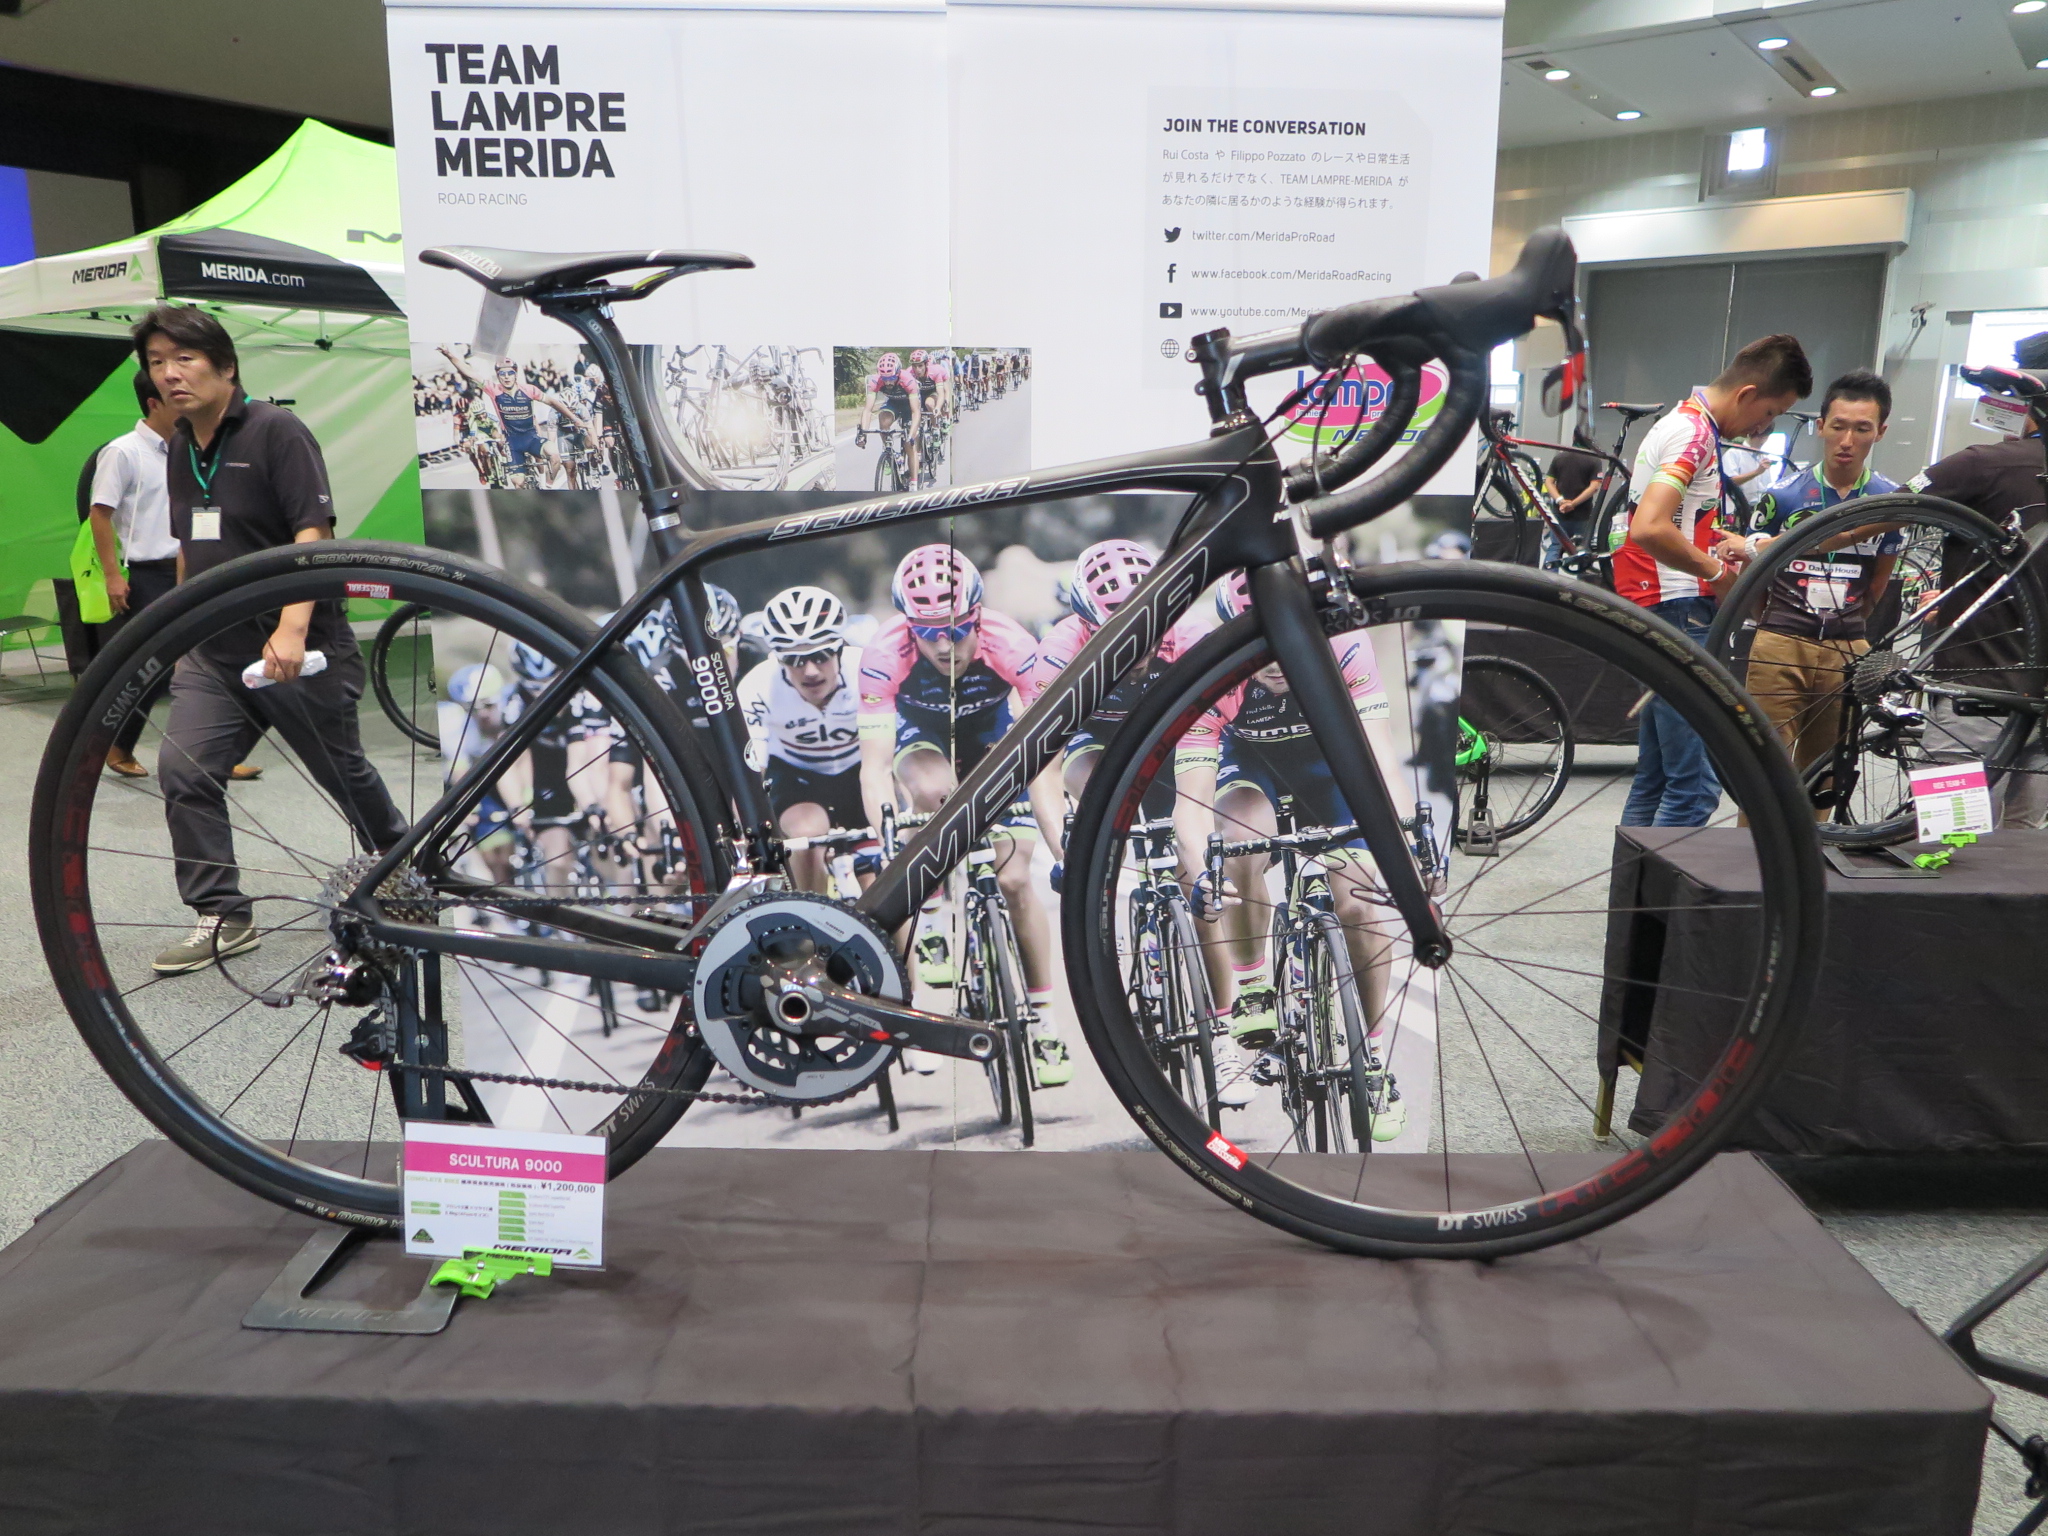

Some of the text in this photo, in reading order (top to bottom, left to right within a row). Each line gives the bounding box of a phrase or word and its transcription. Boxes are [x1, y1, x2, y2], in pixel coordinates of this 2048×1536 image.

[425, 43, 560, 85] TEAM
[431, 90, 627, 132] LAMPRE
[1163, 118, 1367, 136] JOIN THE CONVERSATION
[435, 137, 616, 178] MERIDA
[1163, 149, 1410, 165] Rui Costa や Filippo Pozzato のレースや日常生活
[1162, 171, 1409, 187] が見れるだけでなく、 TEAM LAMPRE-MERIDA が
[438, 192, 528, 206] ROAD RACING
[1162, 194, 1395, 210] あなたの隣に居るかのような経験が得られます。
[1192, 229, 1335, 243] twitter.com/MeridaProRoad
[72, 261, 128, 284] MERIDA
[200, 261, 305, 288] MERIDA.com
[1191, 269, 1391, 283] www.facebook.com/MeridaRoadRacing
[768, 476, 1031, 541] SCULTURA
[312, 553, 450, 577] CONTINENTAL
[101, 656, 163, 730] DT SWISS
[692, 656, 723, 716] 9000
[711, 652, 735, 712] SCULTURA
[907, 546, 1209, 915] MERIDA
[449, 1153, 562, 1173] SCULTURA 9000
[540, 1181, 596, 1194] ¥1,200,000
[1437, 1206, 1528, 1231] DT SWISS
[492, 1244, 572, 1256] MERIDA
